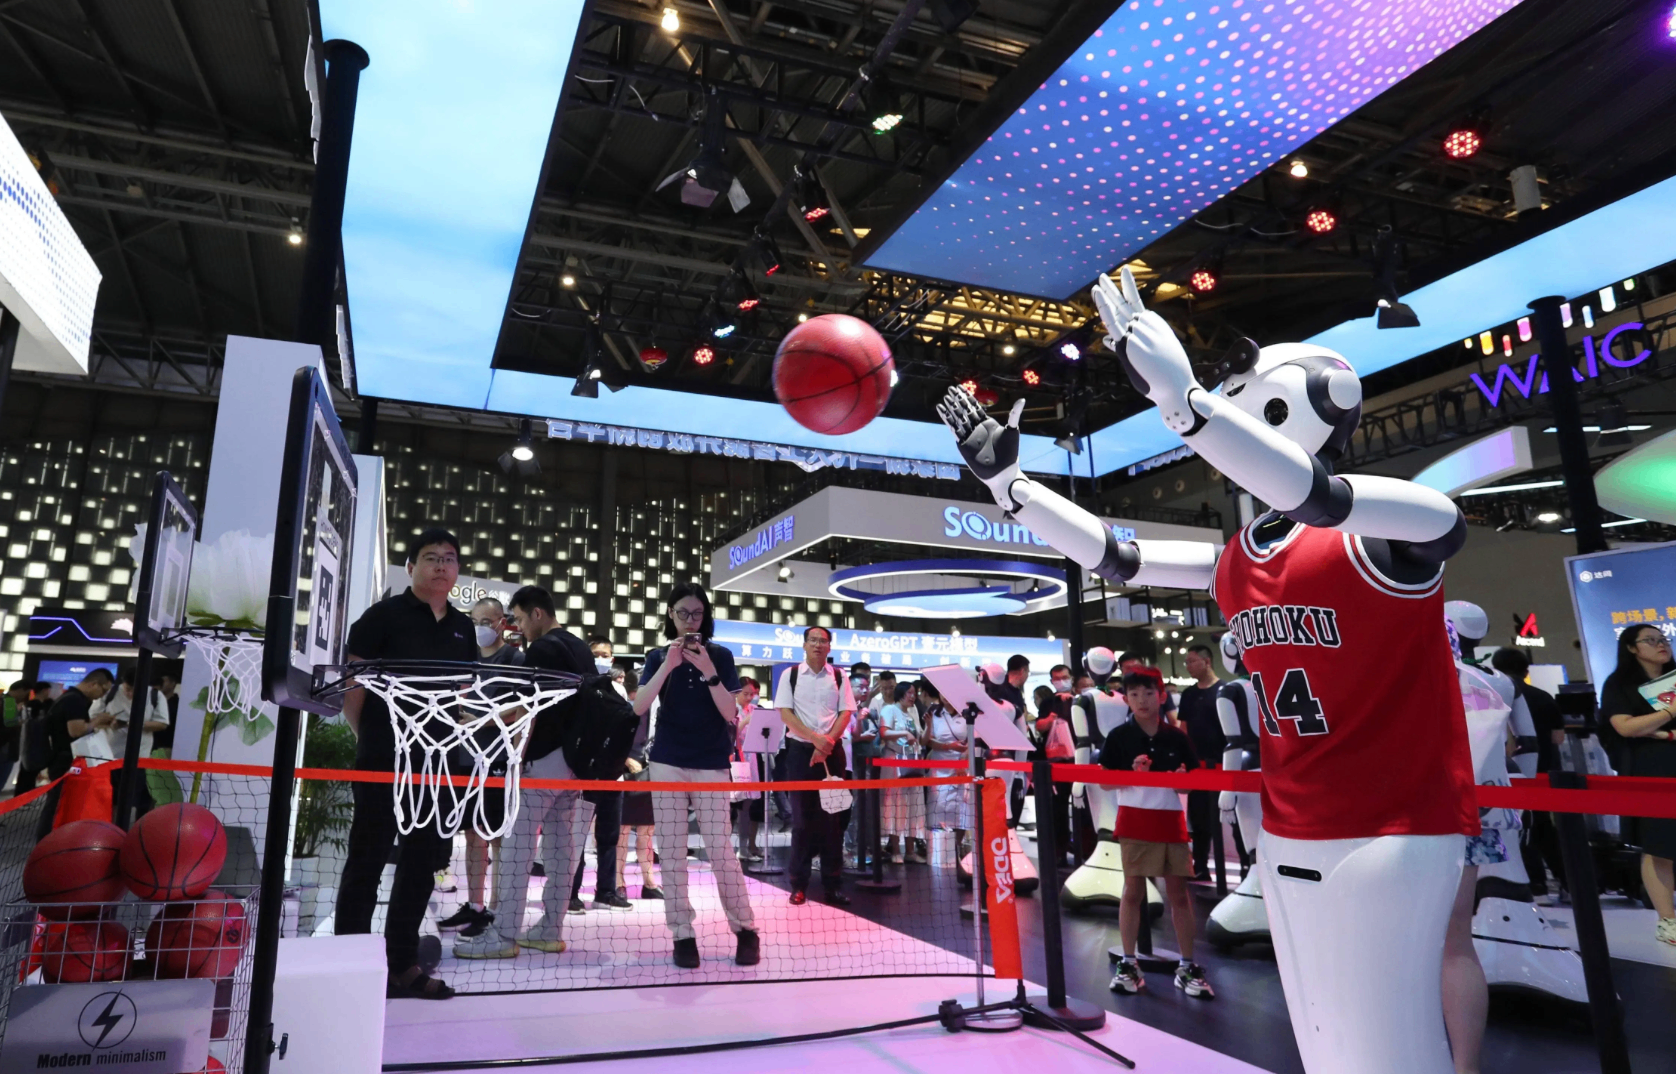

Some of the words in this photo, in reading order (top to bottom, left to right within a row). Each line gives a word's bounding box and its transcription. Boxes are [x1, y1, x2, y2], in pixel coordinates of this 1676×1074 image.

[1469, 322, 1652, 408] WIC
[1250, 667, 1330, 738] 14
[36, 1053, 92, 1069] Modern
[96, 1048, 167, 1065] minimalism
